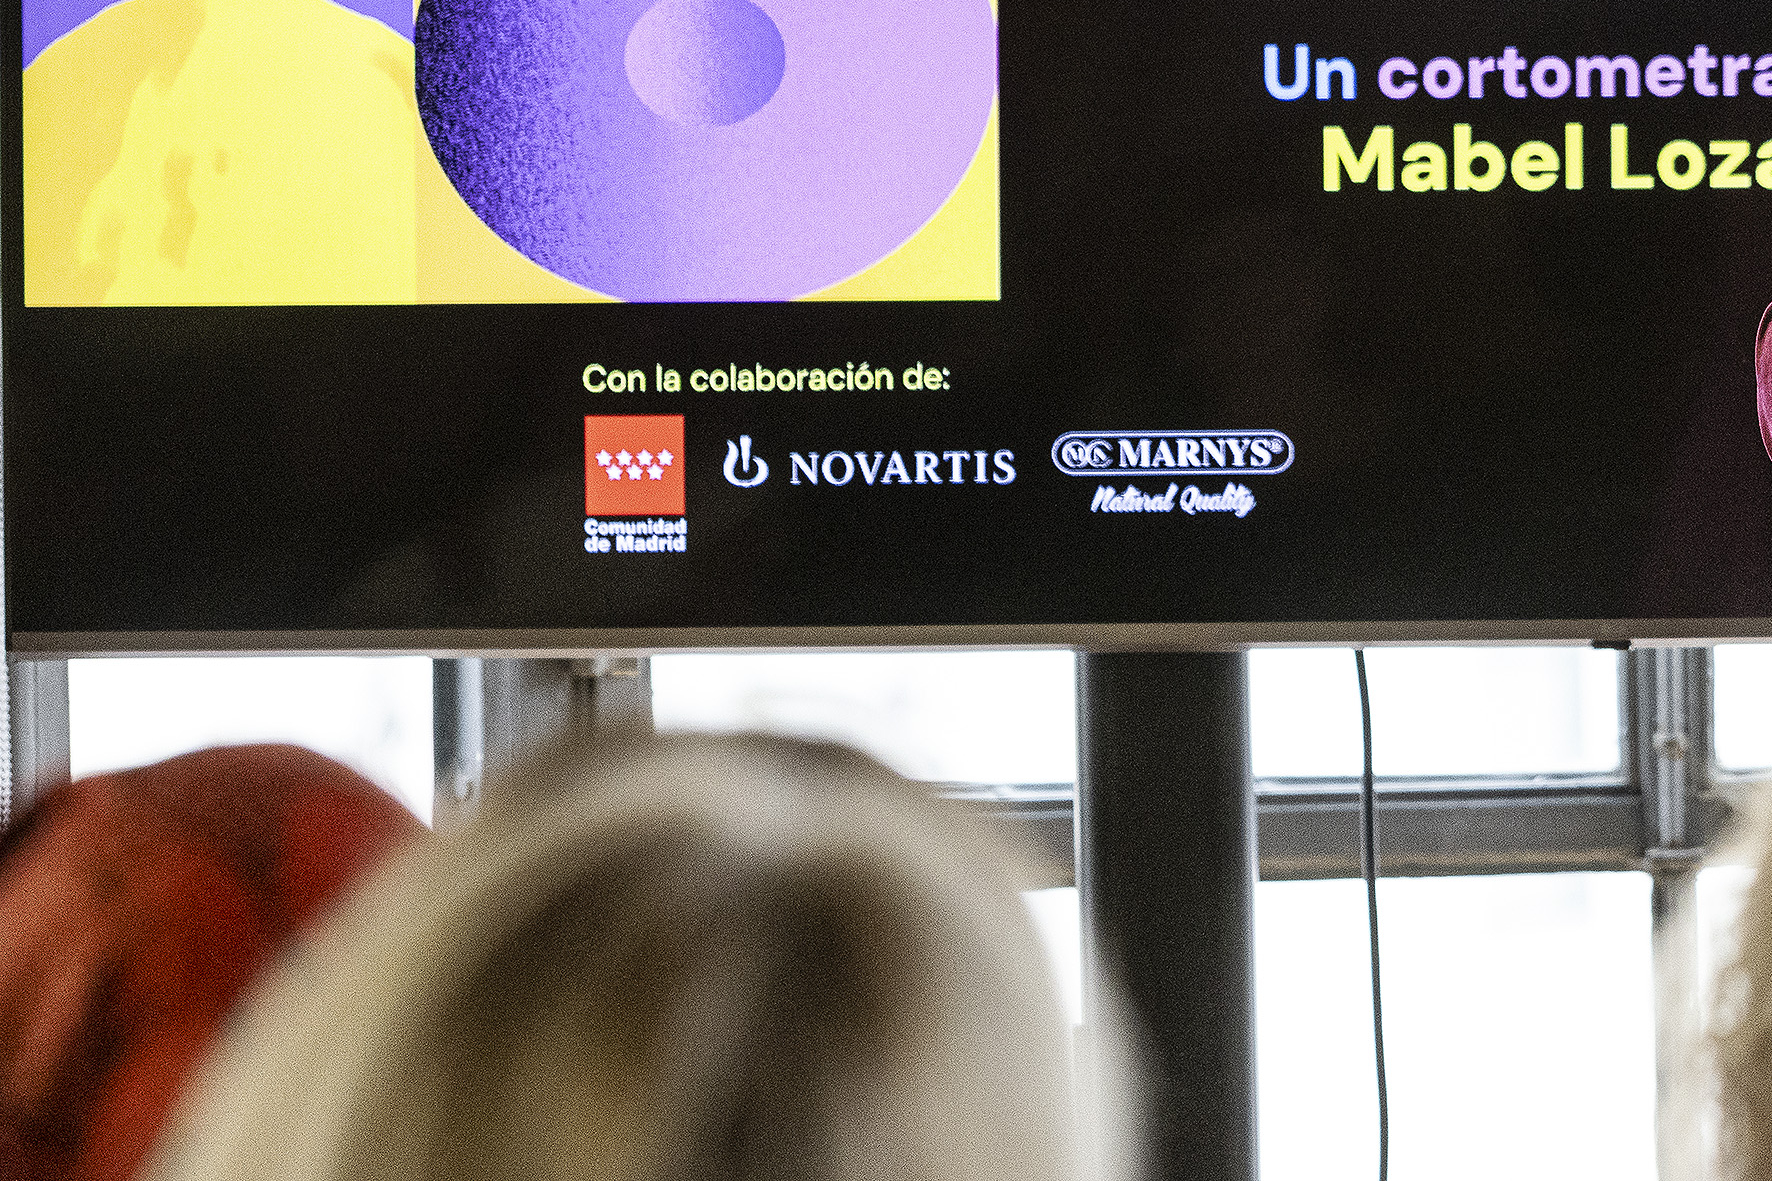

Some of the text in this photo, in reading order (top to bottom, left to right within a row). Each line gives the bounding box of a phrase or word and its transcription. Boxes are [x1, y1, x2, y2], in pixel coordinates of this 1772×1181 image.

[1264, 43, 1358, 102] Un
[1322, 123, 1584, 193] Mabel
[581, 361, 951, 394] Con la colaboración de:
[790, 450, 1017, 486] NOVARTIS
[1091, 482, 1257, 518] Natural Quality
[583, 517, 688, 536] Comunidad
[583, 535, 688, 554] de Madrid
